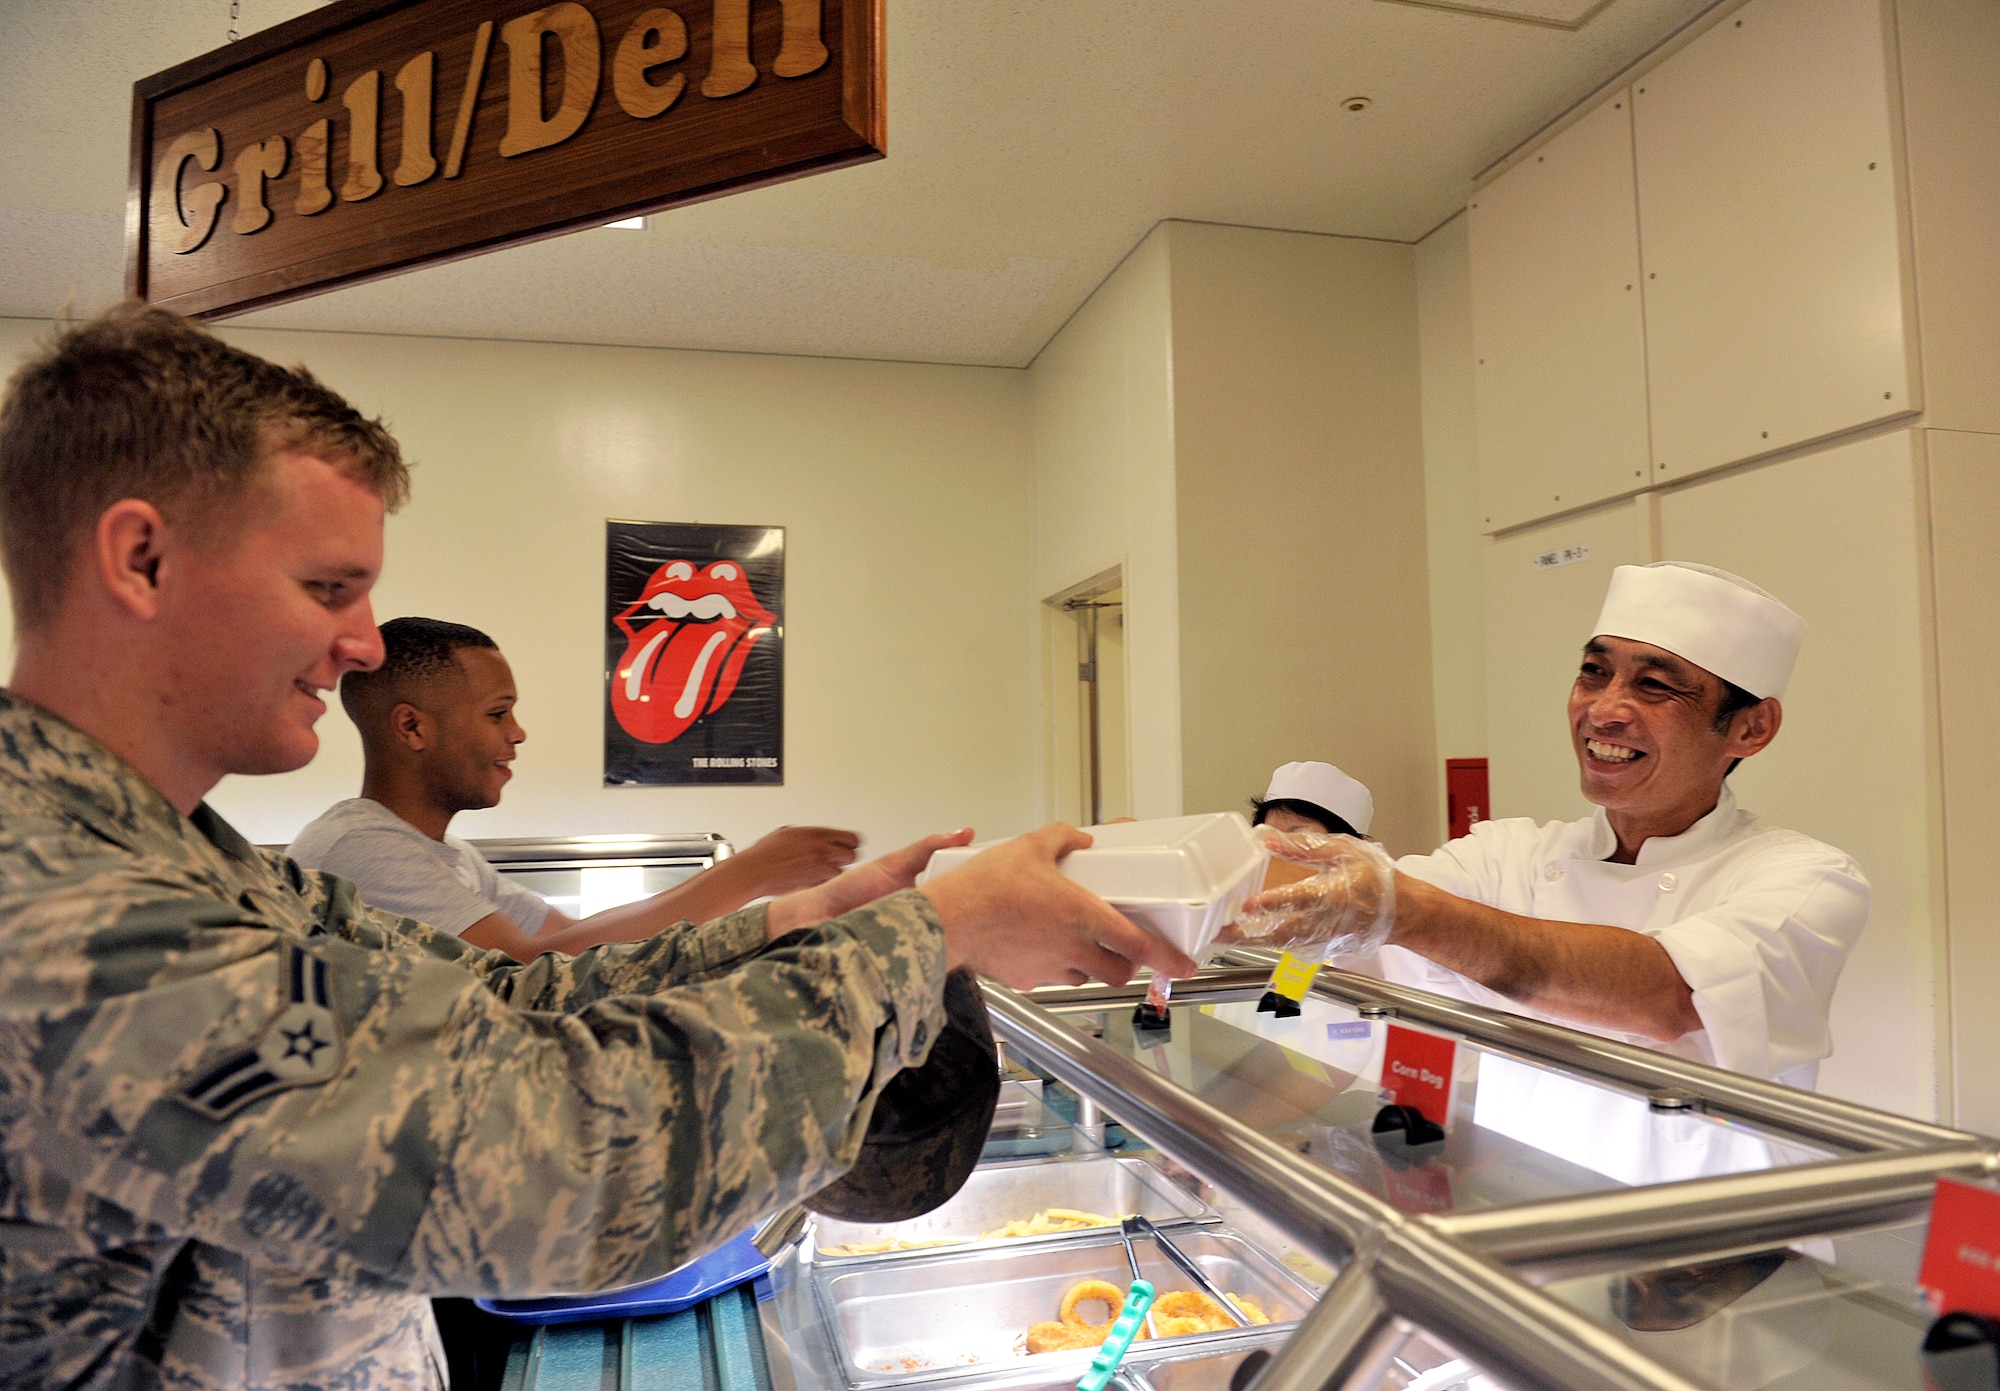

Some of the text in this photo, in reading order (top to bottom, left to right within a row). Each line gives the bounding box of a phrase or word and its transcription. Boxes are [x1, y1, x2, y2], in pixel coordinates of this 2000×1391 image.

[692, 757, 778, 768] THE ROLLING STONES
[1391, 1060, 1445, 1091] Corn Dog
